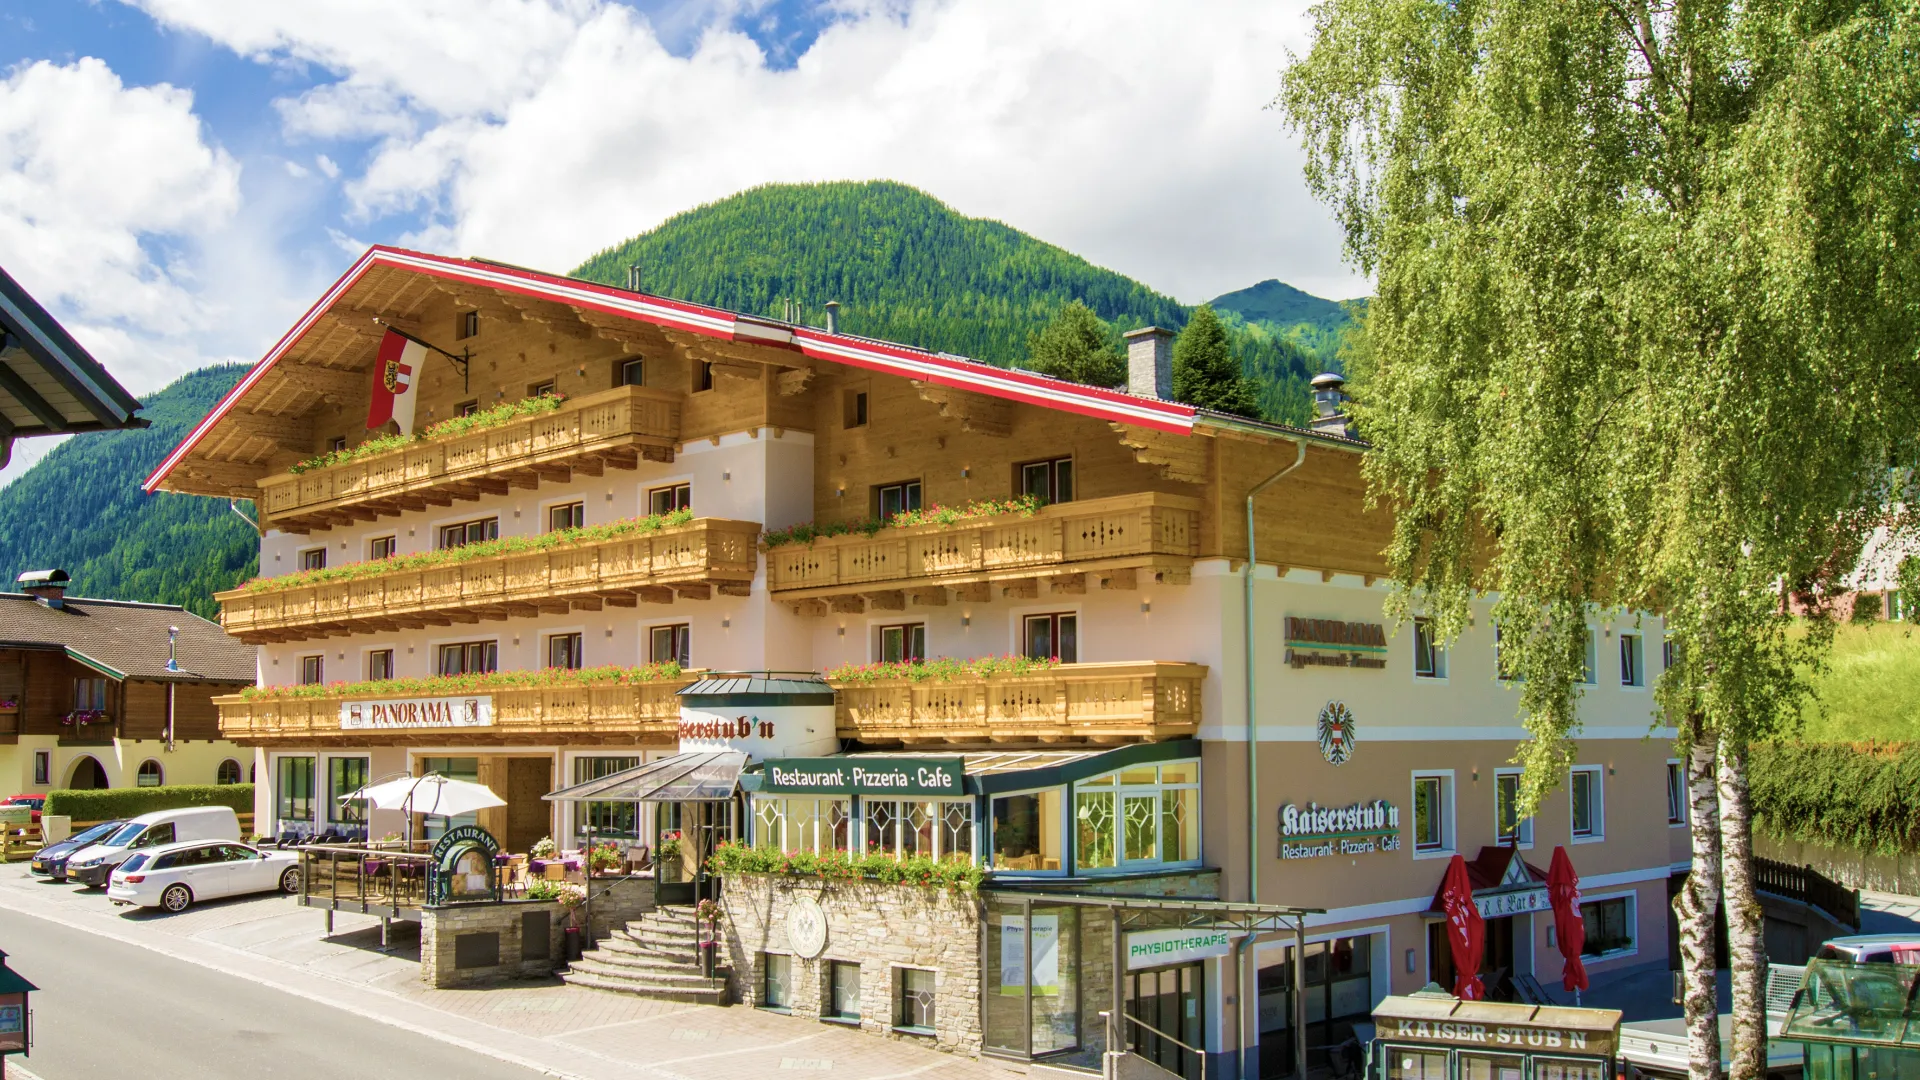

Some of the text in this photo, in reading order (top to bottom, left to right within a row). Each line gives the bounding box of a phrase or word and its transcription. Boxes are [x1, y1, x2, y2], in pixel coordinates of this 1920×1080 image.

[372, 701, 452, 724] PANORAMA
[773, 766, 952, 787] Restaurant Pizzeria Cafe
[1282, 799, 1399, 835] Kaiserstub'n
[434, 828, 498, 858] RESTAURANT
[1282, 835, 1400, 859] Restaurant Pizzeria Café
[1006, 925, 1053, 933] Physierapie
[1131, 933, 1227, 957] PHYSIOTHERAPIE
